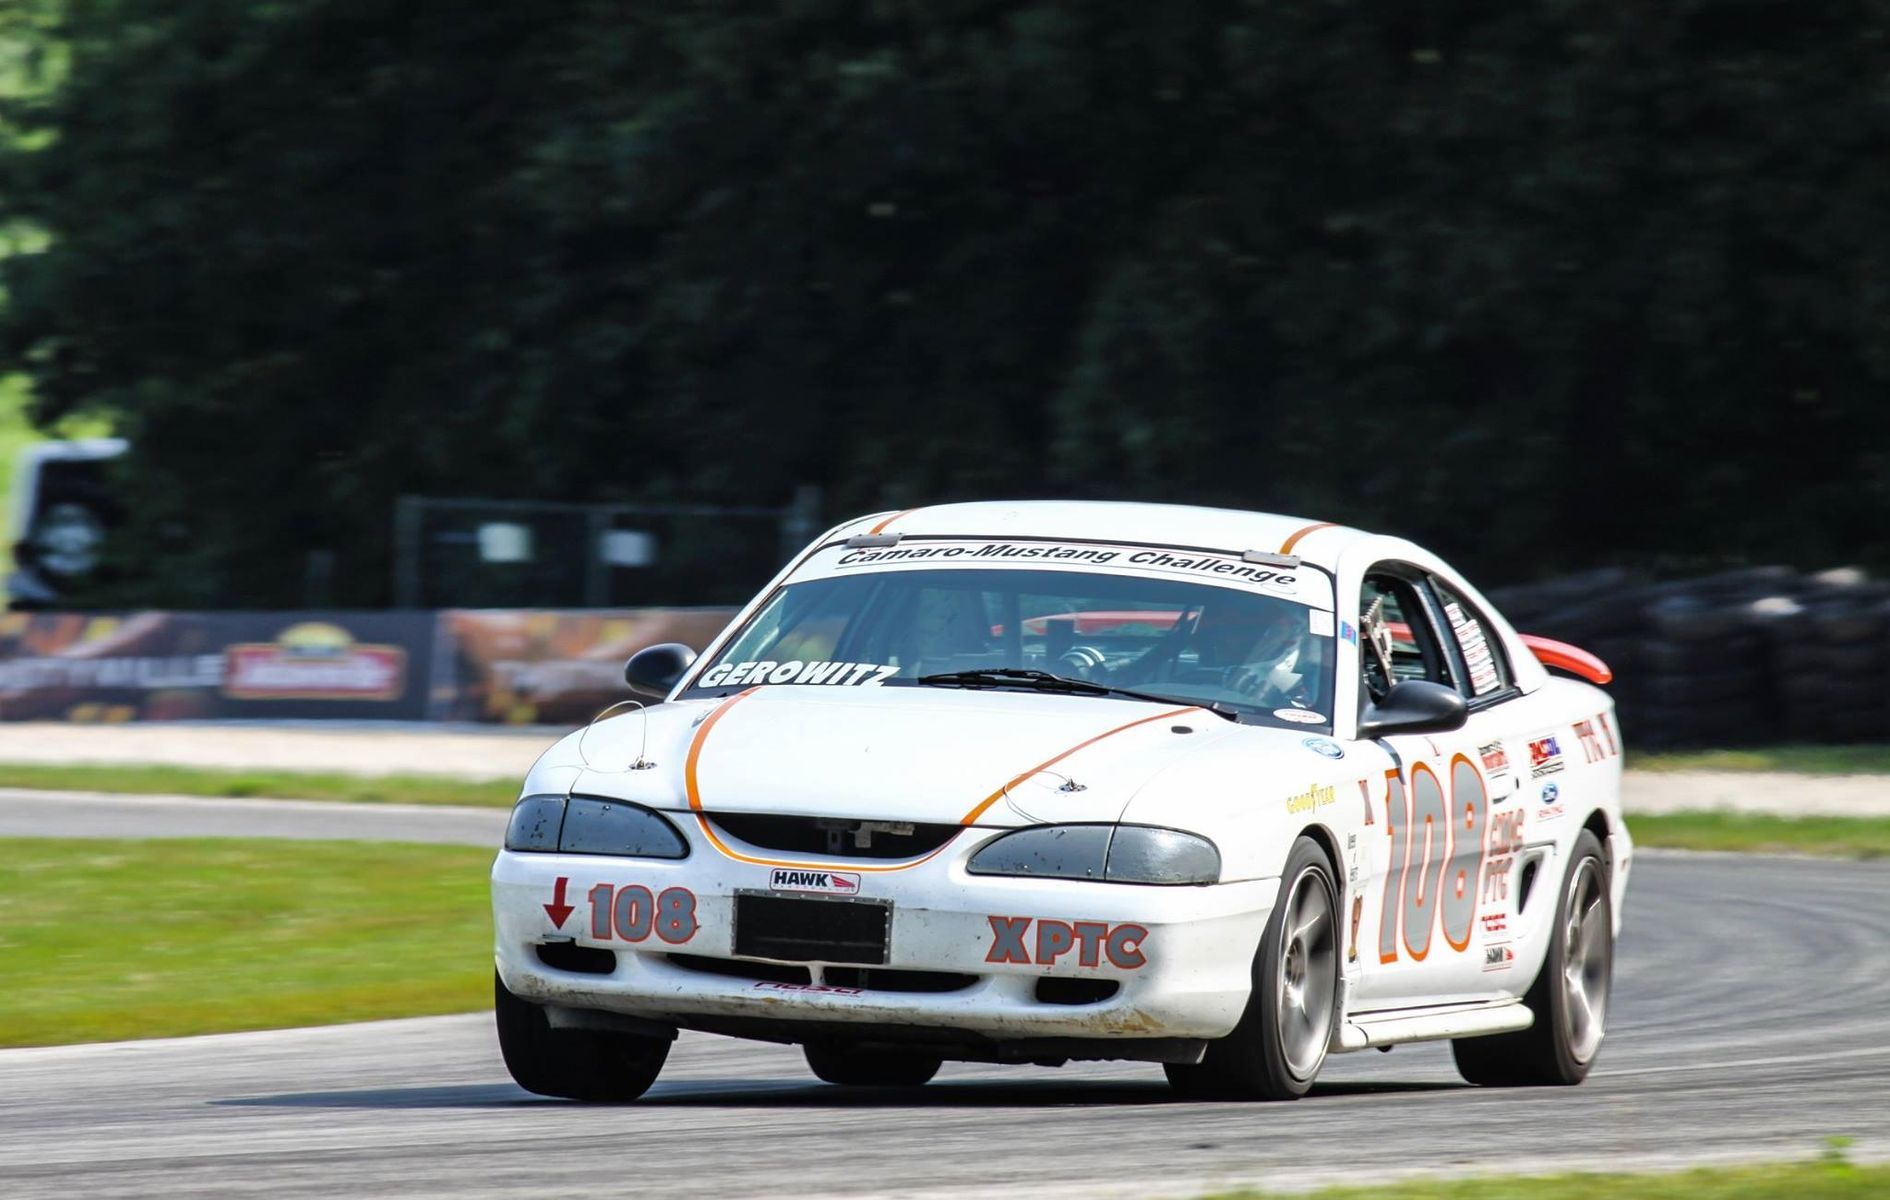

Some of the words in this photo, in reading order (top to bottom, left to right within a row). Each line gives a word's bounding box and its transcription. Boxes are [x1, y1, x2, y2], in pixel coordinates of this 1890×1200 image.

[838, 545, 1121, 565] Camaro-Mustang
[1128, 551, 1297, 585] Challenge
[699, 660, 901, 688] GEROWITZ
[1378, 752, 1488, 965] 108
[774, 871, 830, 887] HAWK
[587, 883, 698, 944] 108
